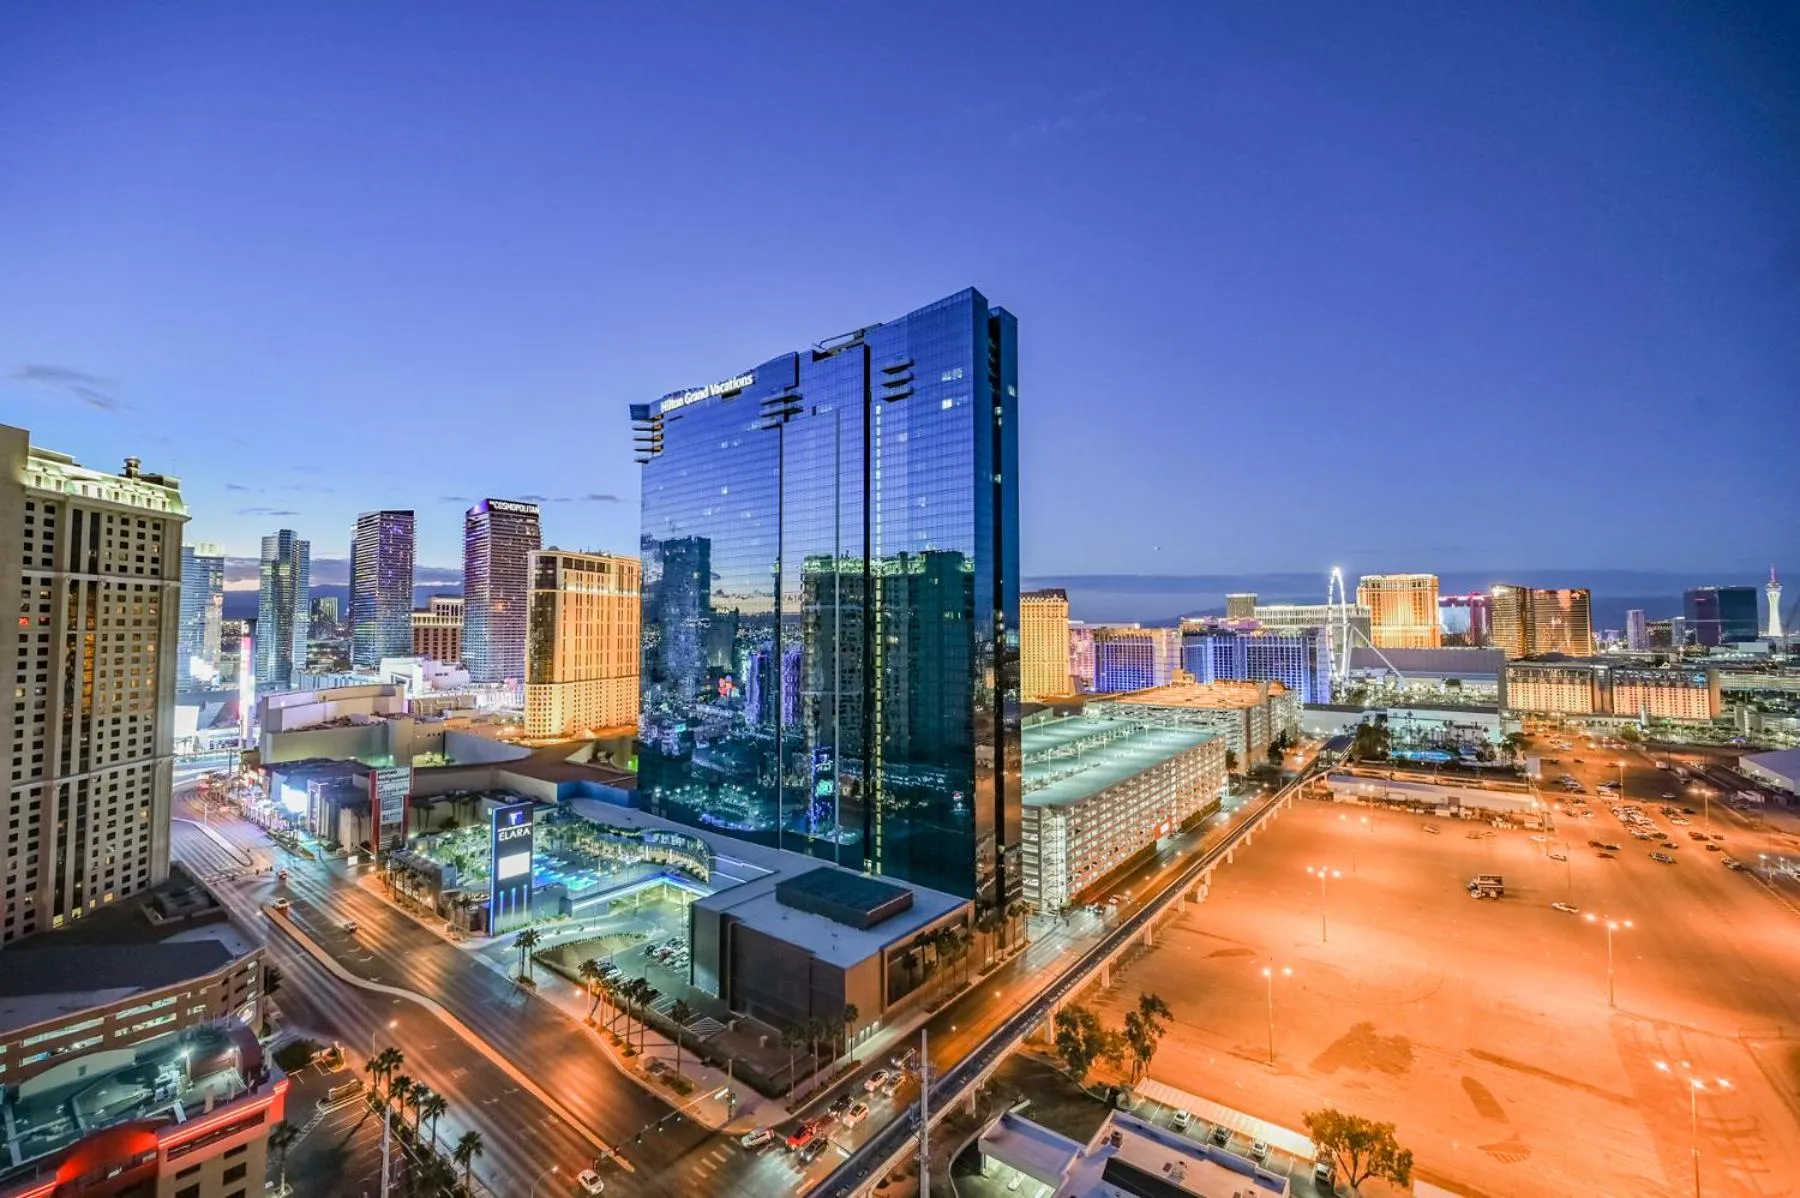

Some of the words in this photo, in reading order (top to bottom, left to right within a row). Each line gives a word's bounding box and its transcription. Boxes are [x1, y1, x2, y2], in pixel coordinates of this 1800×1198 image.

[660, 397, 684, 412] Hilton
[684, 386, 708, 403] Grand
[709, 374, 753, 396] Vacations
[493, 501, 540, 514] COSMOPOLITAN
[498, 827, 530, 841] ELARA
